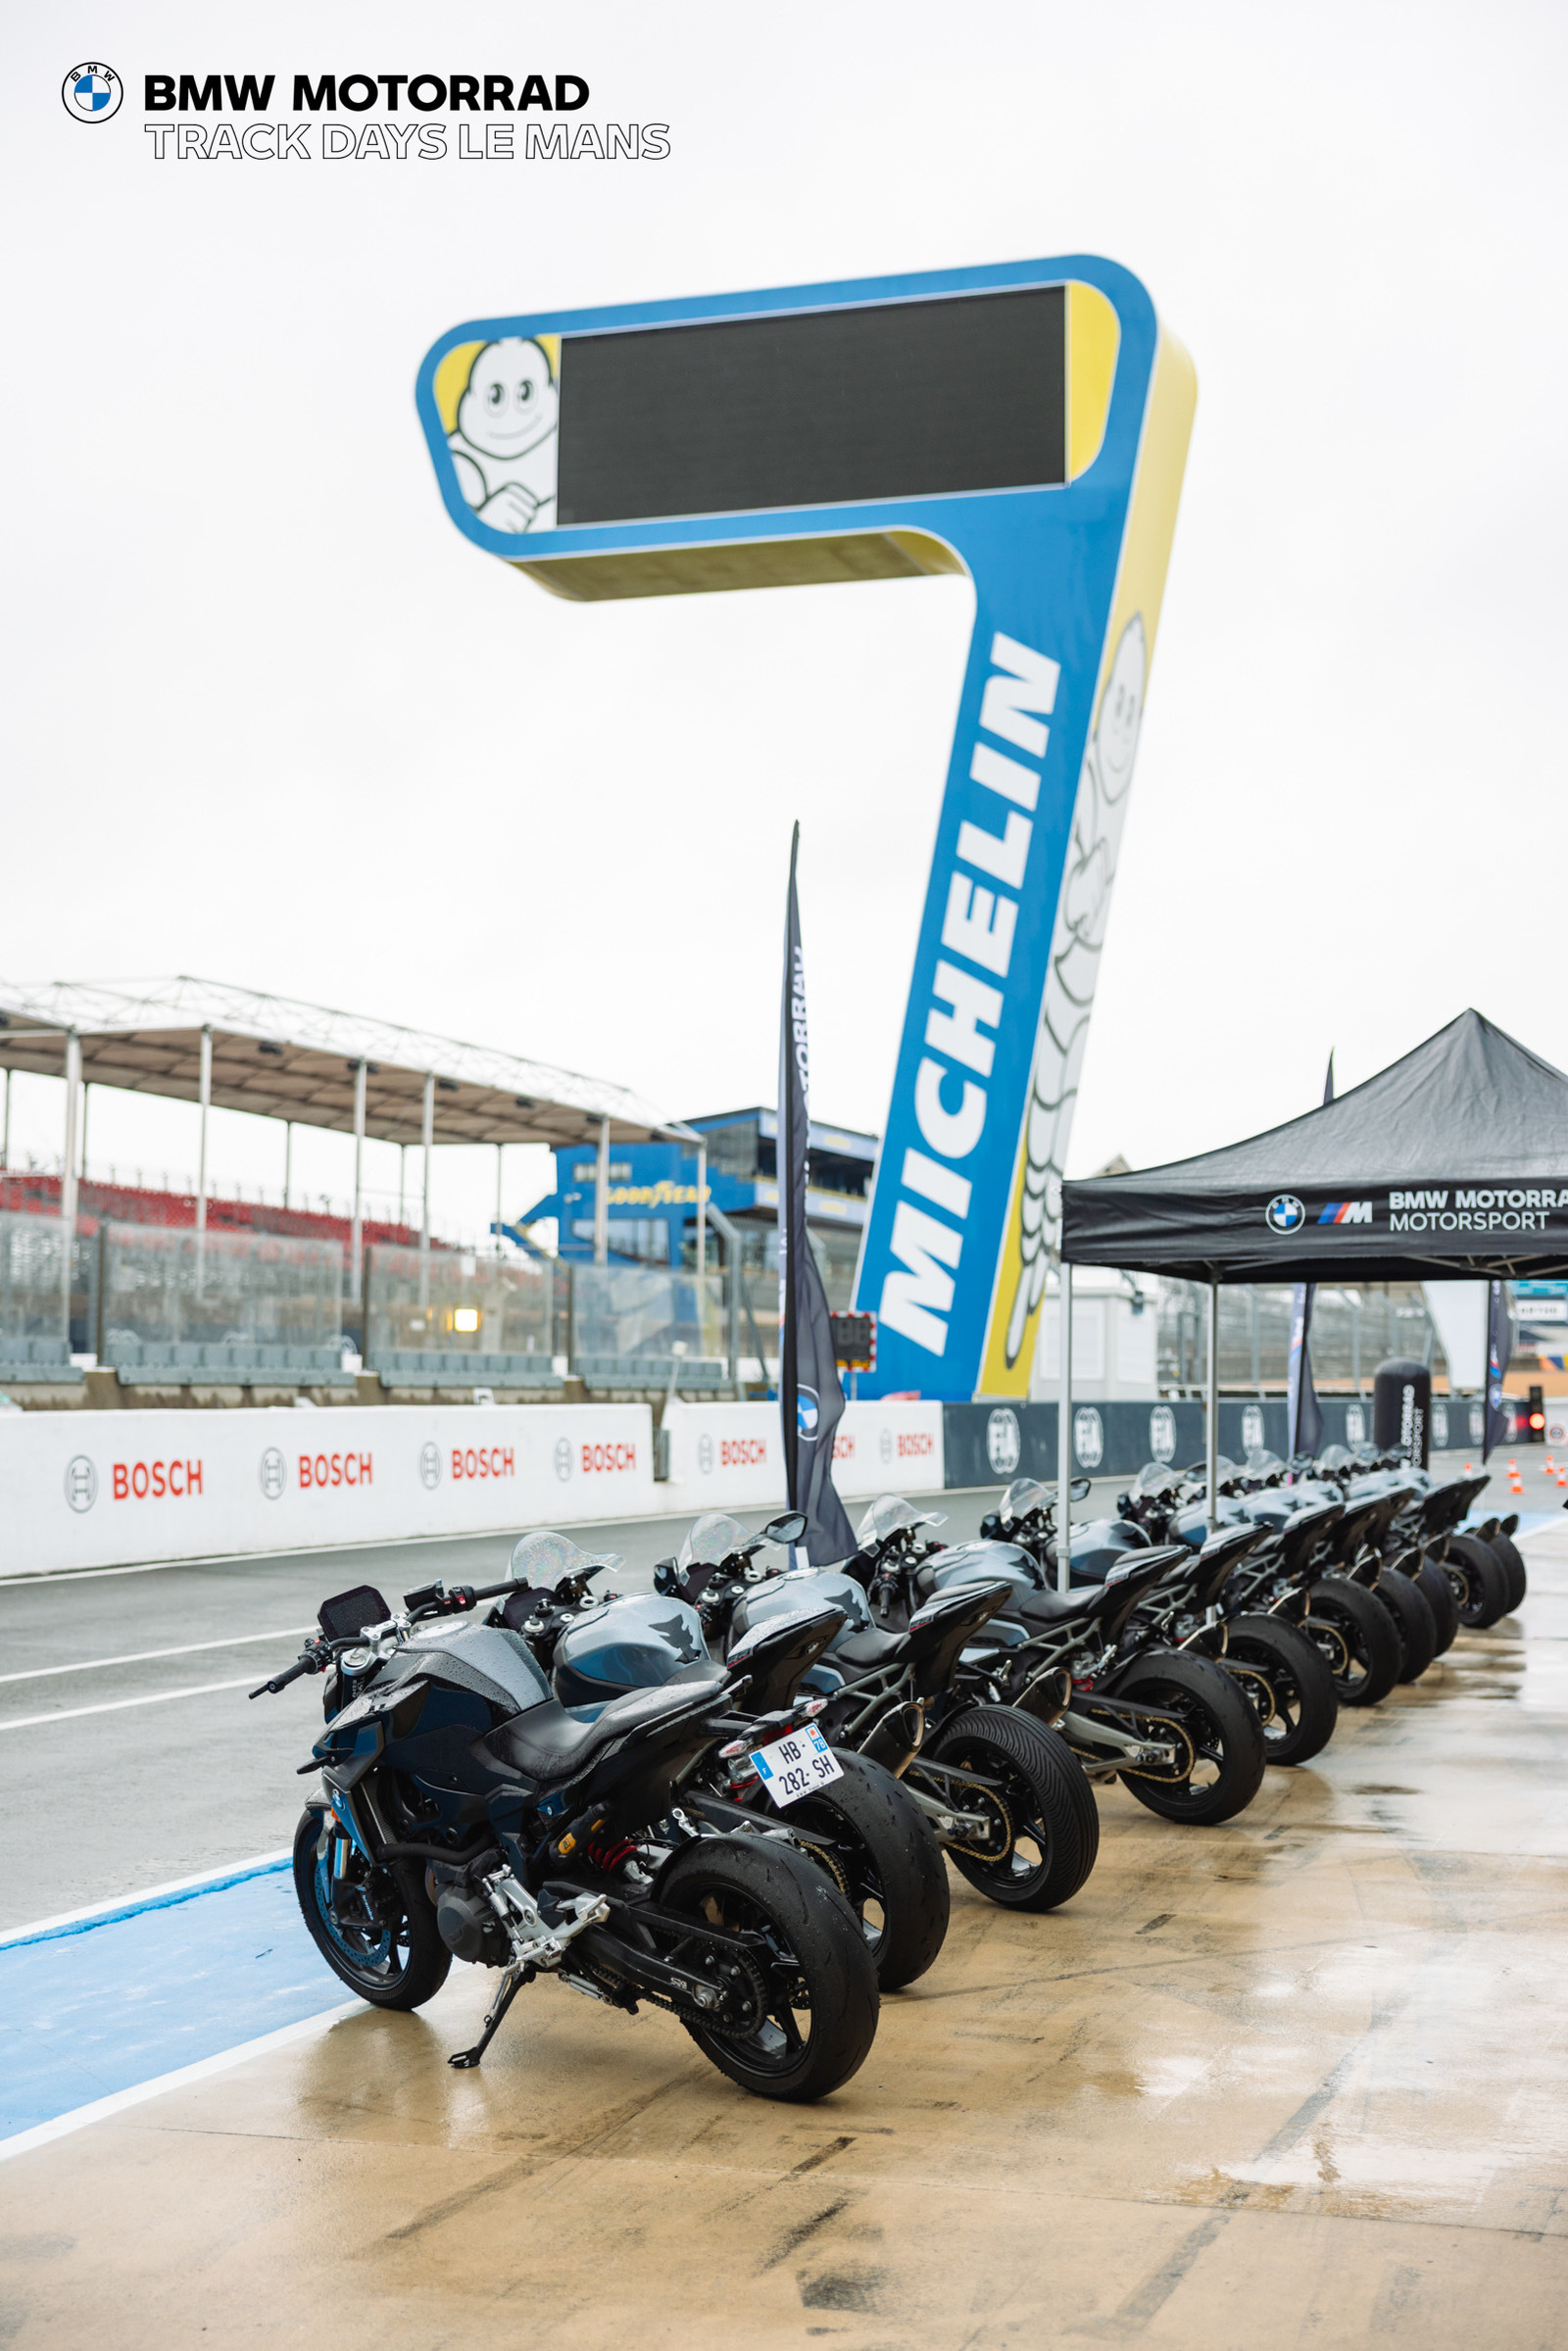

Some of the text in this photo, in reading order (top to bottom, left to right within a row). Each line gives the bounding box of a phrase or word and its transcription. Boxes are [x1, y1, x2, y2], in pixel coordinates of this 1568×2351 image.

[878, 630, 1062, 1357] MICHELIN
[1389, 1189, 1568, 1209] BMW MOTORRA
[1390, 1211, 1550, 1231] MOTORSPORT
[1400, 1384, 1416, 1458] OTORRAD
[582, 1444, 636, 1472] BOSCH
[721, 1438, 766, 1465] BOSCH
[832, 1435, 856, 1459] SCH
[898, 1434, 934, 1458] BOSCH
[299, 1452, 372, 1489] BOSCH
[452, 1447, 514, 1480] BOSCH
[113, 1459, 203, 1500] BOSCH
[812, 1739, 827, 1751] 78
